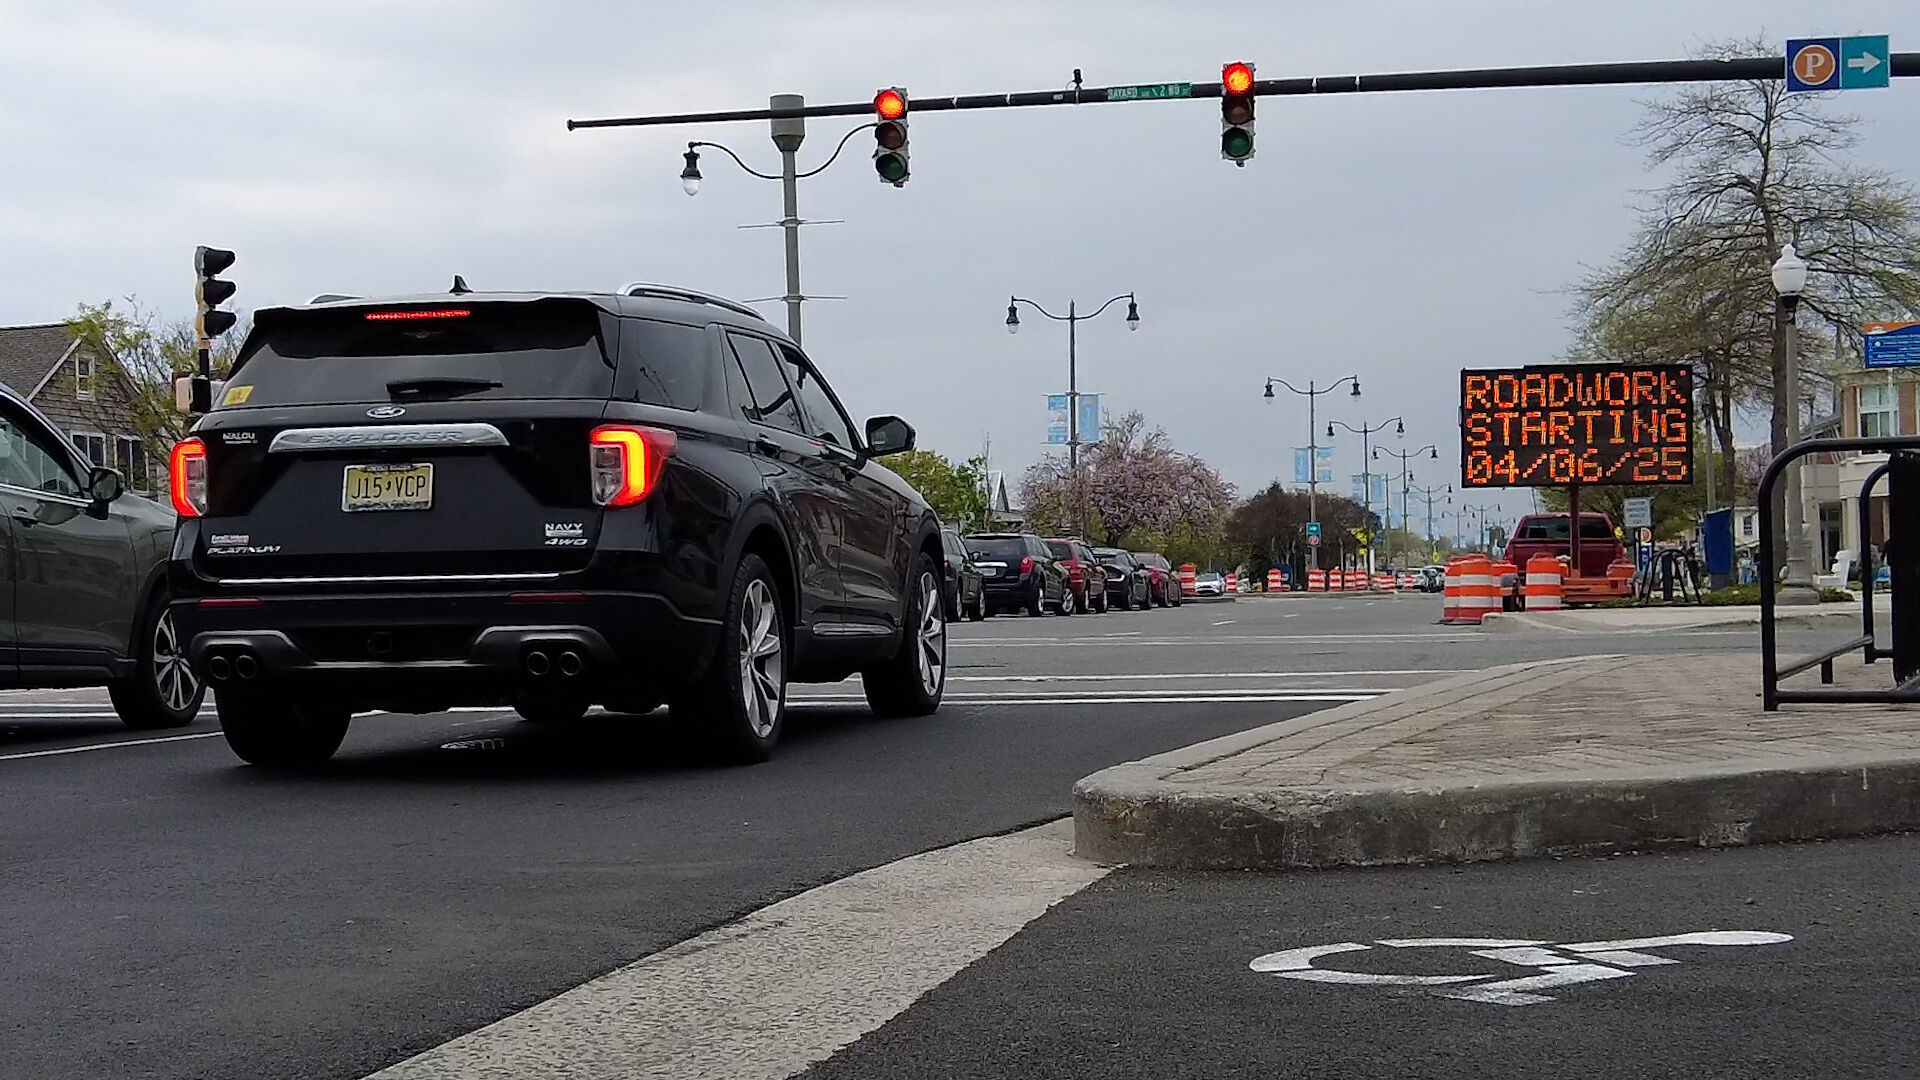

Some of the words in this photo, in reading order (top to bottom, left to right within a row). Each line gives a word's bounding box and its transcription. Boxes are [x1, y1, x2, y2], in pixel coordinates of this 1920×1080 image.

[1804, 53, 1825, 78] P
[1466, 370, 1687, 409] ROADWORK
[308, 431, 464, 445] EXPLORER
[1466, 408, 1687, 447] STARTING
[1466, 446, 1687, 484] 04/06/25
[545, 523, 583, 531] NAVY
